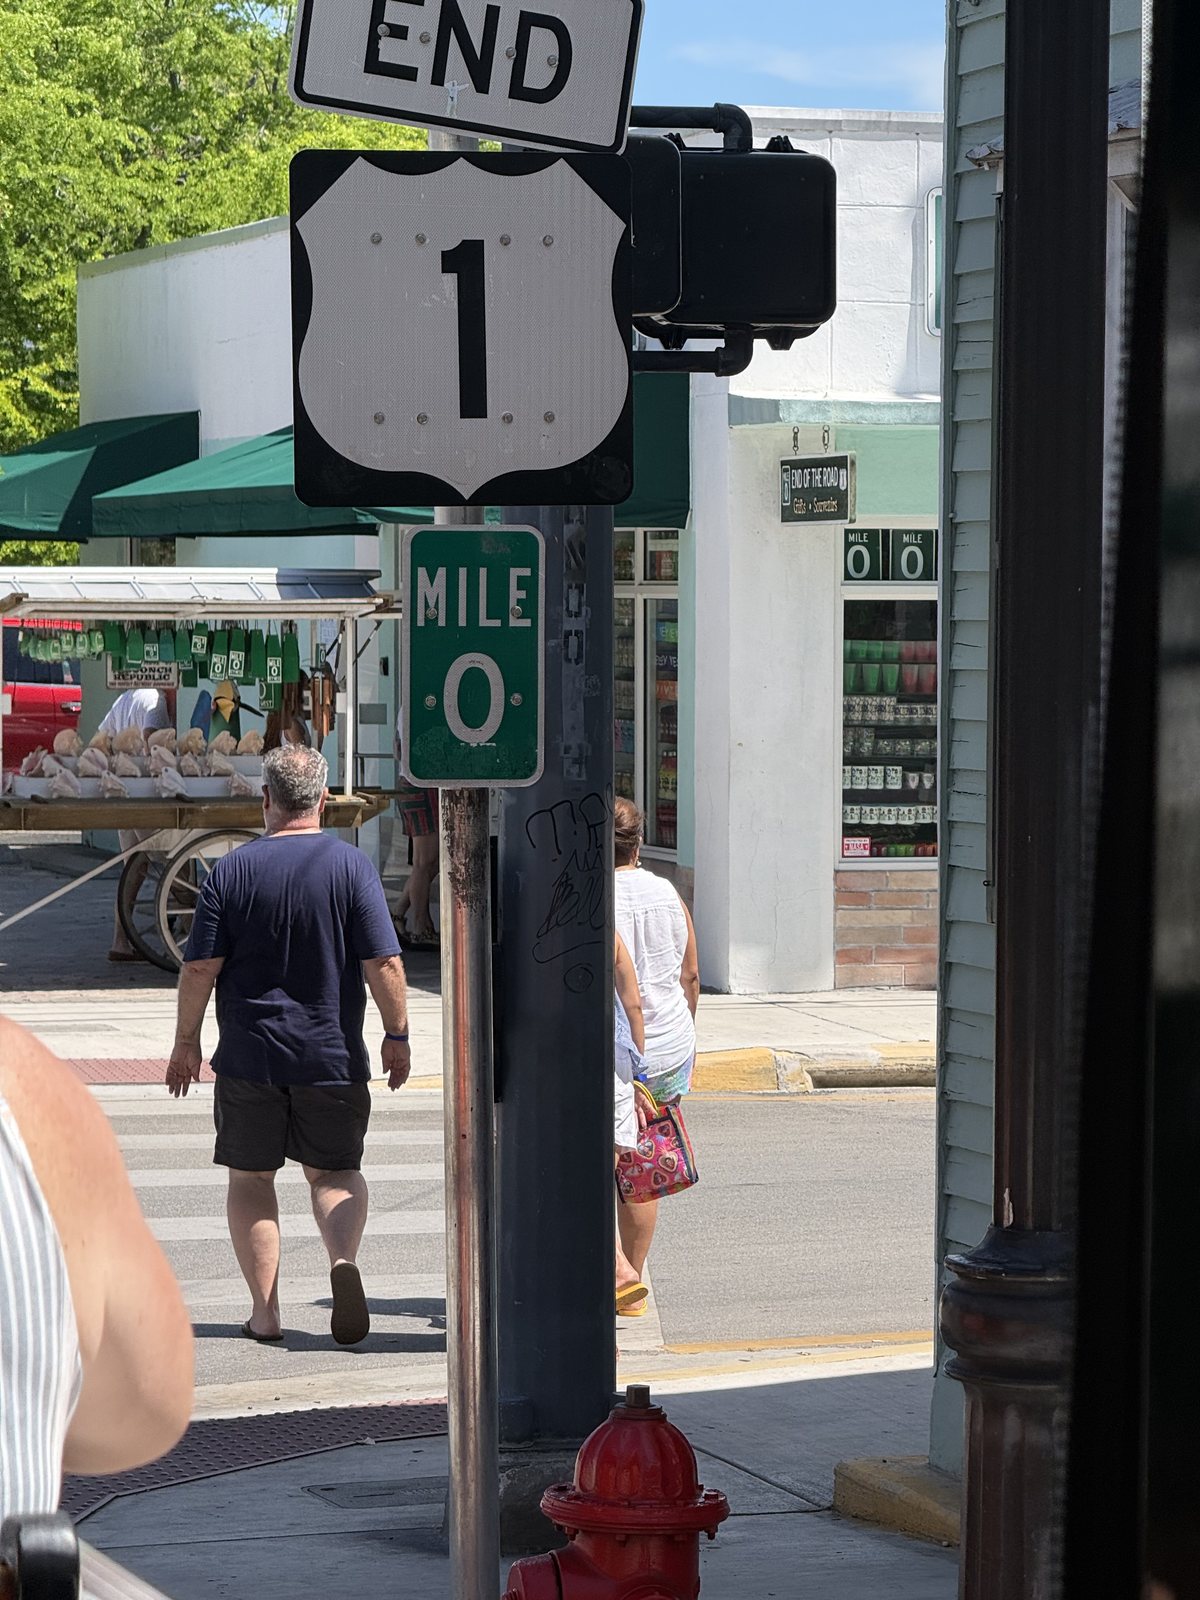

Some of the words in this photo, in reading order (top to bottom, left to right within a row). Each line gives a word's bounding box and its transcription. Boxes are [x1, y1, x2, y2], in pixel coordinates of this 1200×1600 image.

[363, 0, 573, 105] END
[441, 239, 488, 419] 1
[791, 468, 803, 489] END
[803, 468, 811, 488] OF
[811, 467, 822, 488] THE
[822, 466, 839, 487] ROAD
[848, 532, 869, 543] MILE
[902, 533, 923, 544] MILE
[847, 545, 870, 578] 0
[900, 545, 924, 579] 0
[416, 567, 532, 627] MILE
[134, 666, 173, 674] ONCH
[214, 663, 222, 673] 0
[233, 660, 240, 670] 0
[271, 666, 278, 676] 0
[113, 673, 171, 681] REPUBLIC
[443, 652, 505, 744] 0
